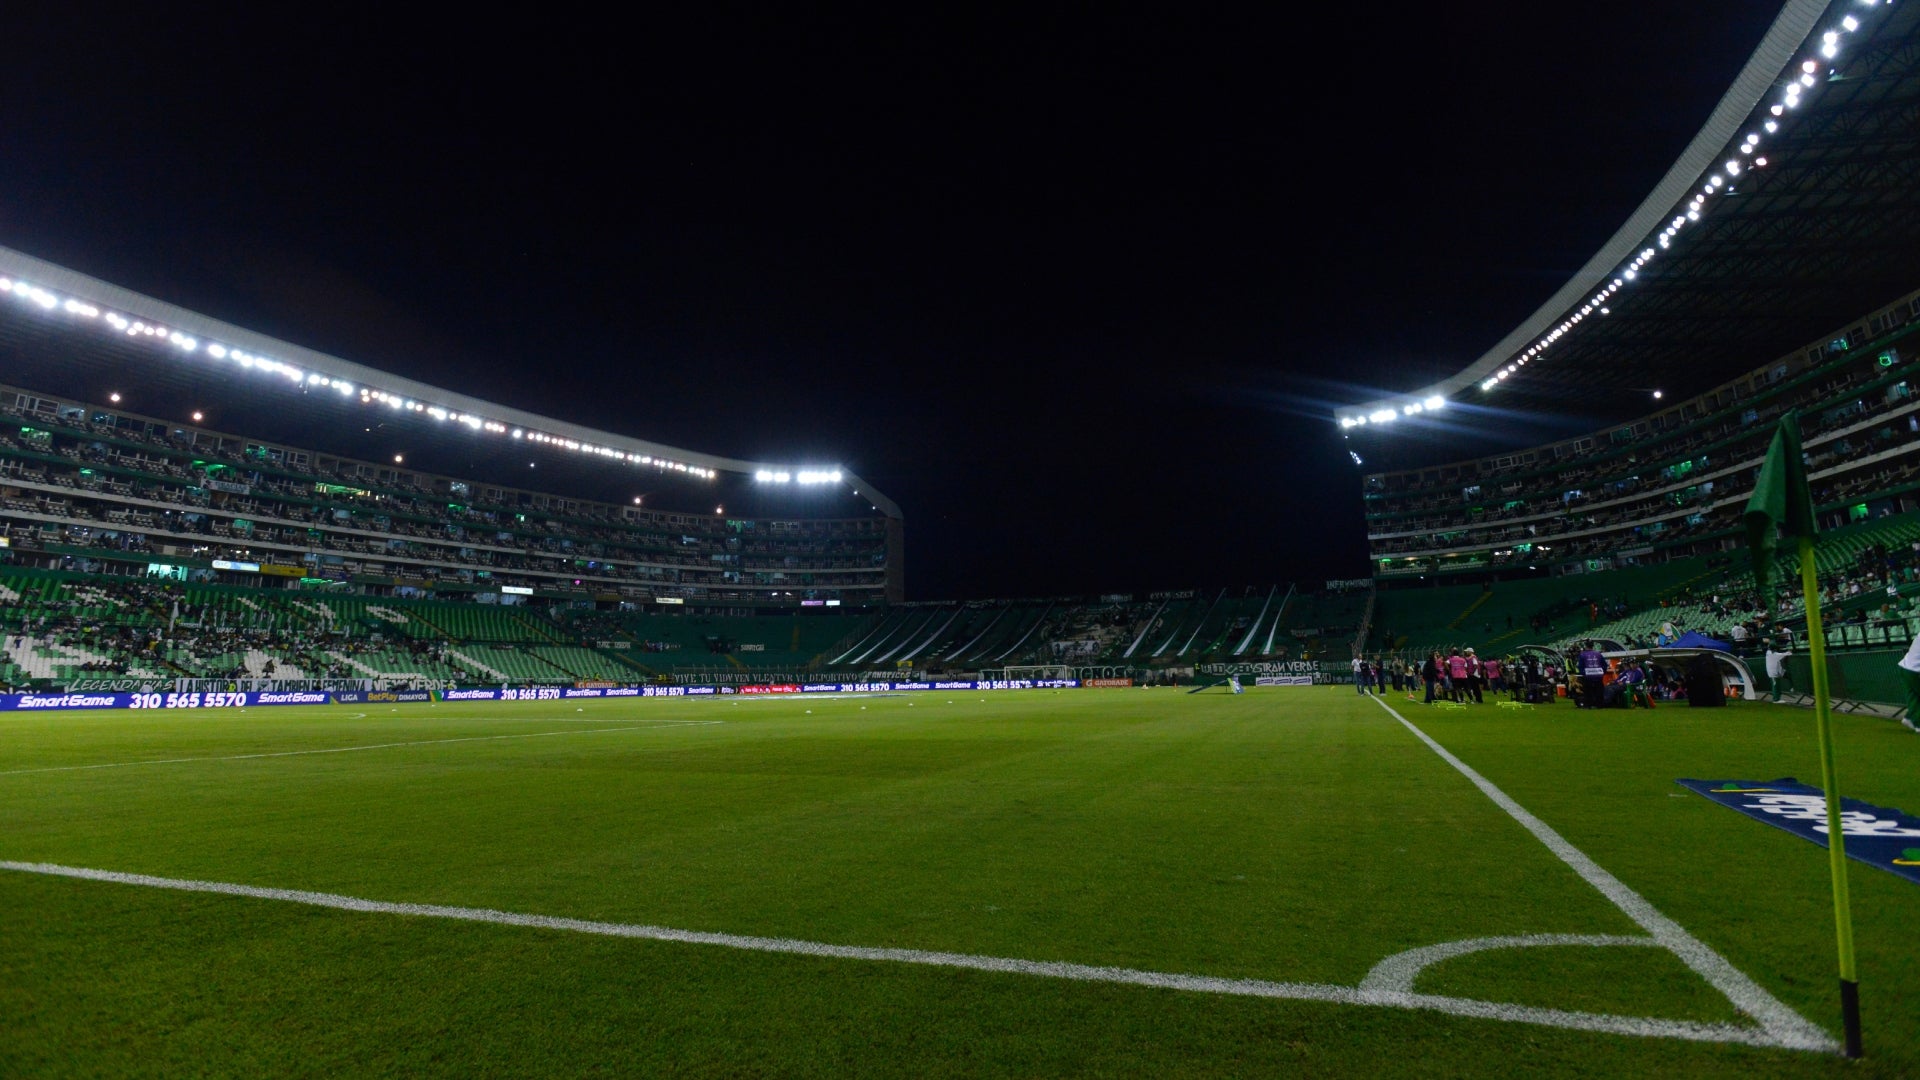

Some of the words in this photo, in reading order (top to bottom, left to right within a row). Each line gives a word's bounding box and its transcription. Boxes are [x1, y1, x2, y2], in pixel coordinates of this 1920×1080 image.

[1286, 661, 1319, 672] VERDE
[699, 674, 711, 683] TU
[809, 673, 857, 683] DEPORTIVO
[1094, 679, 1129, 687] GATORADE
[196, 679, 238, 691] HISTOR
[803, 684, 836, 692] SmartGame
[840, 683, 853, 692] 310
[854, 683, 868, 692] 565
[870, 682, 890, 691] 5570
[895, 682, 930, 690] SmartGame
[976, 680, 991, 689] 310
[992, 680, 1007, 689] 565
[340, 693, 358, 701] LIGA
[367, 692, 398, 702] BetPlay
[398, 693, 428, 701] DIMAYOR
[447, 690, 495, 699] SmartGame
[500, 688, 517, 701] 310
[518, 688, 537, 701] 565
[538, 688, 560, 700] 5570
[565, 689, 601, 697] SmartGame
[605, 688, 639, 697] SmartGame
[642, 687, 654, 697] 310
[655, 687, 667, 697] 565
[668, 687, 685, 697] 5570
[17, 694, 116, 708] SmartGame
[128, 693, 162, 709] 310
[166, 693, 200, 709] 565
[204, 692, 247, 708] 5570
[257, 692, 325, 704] SmartGame
